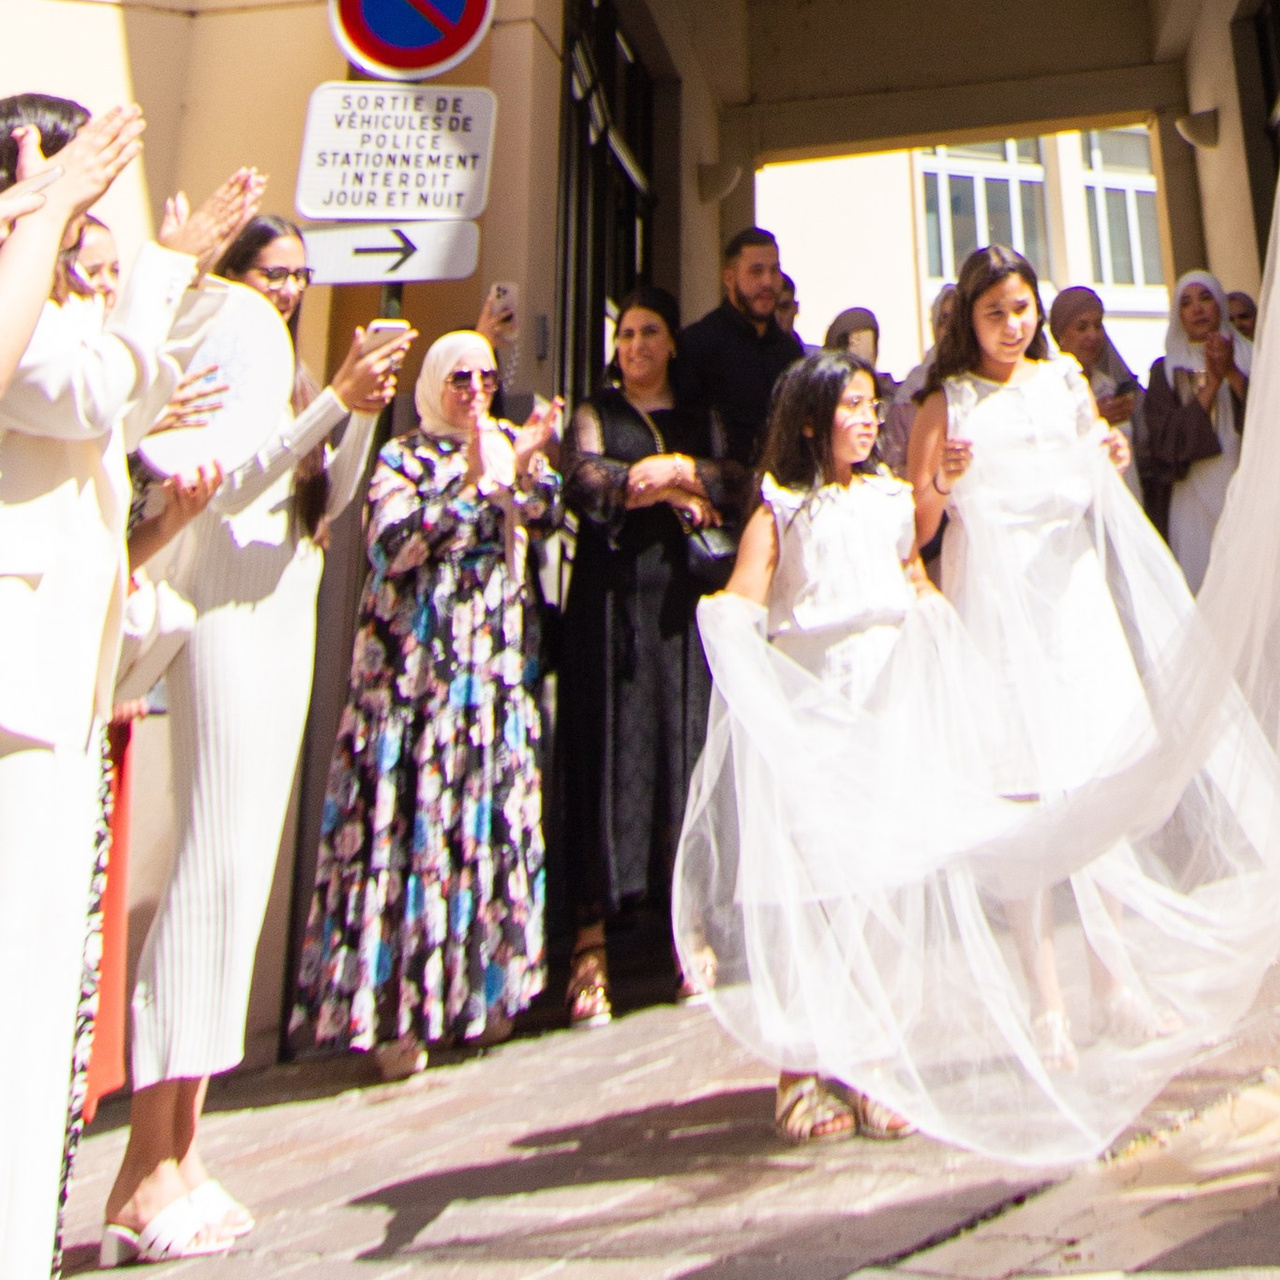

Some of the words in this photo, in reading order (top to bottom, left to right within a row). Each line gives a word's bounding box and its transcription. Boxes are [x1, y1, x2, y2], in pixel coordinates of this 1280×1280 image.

[341, 95, 424, 112] SORTIE
[435, 96, 463, 114] DE
[448, 116, 473, 132] DE
[359, 134, 441, 150] POLICE
[316, 152, 480, 170] STATIONNEMENT
[341, 172, 450, 187] INTERDIT
[322, 191, 378, 206] JOUR
[386, 192, 410, 207] ET
[416, 192, 465, 208] NUIT
